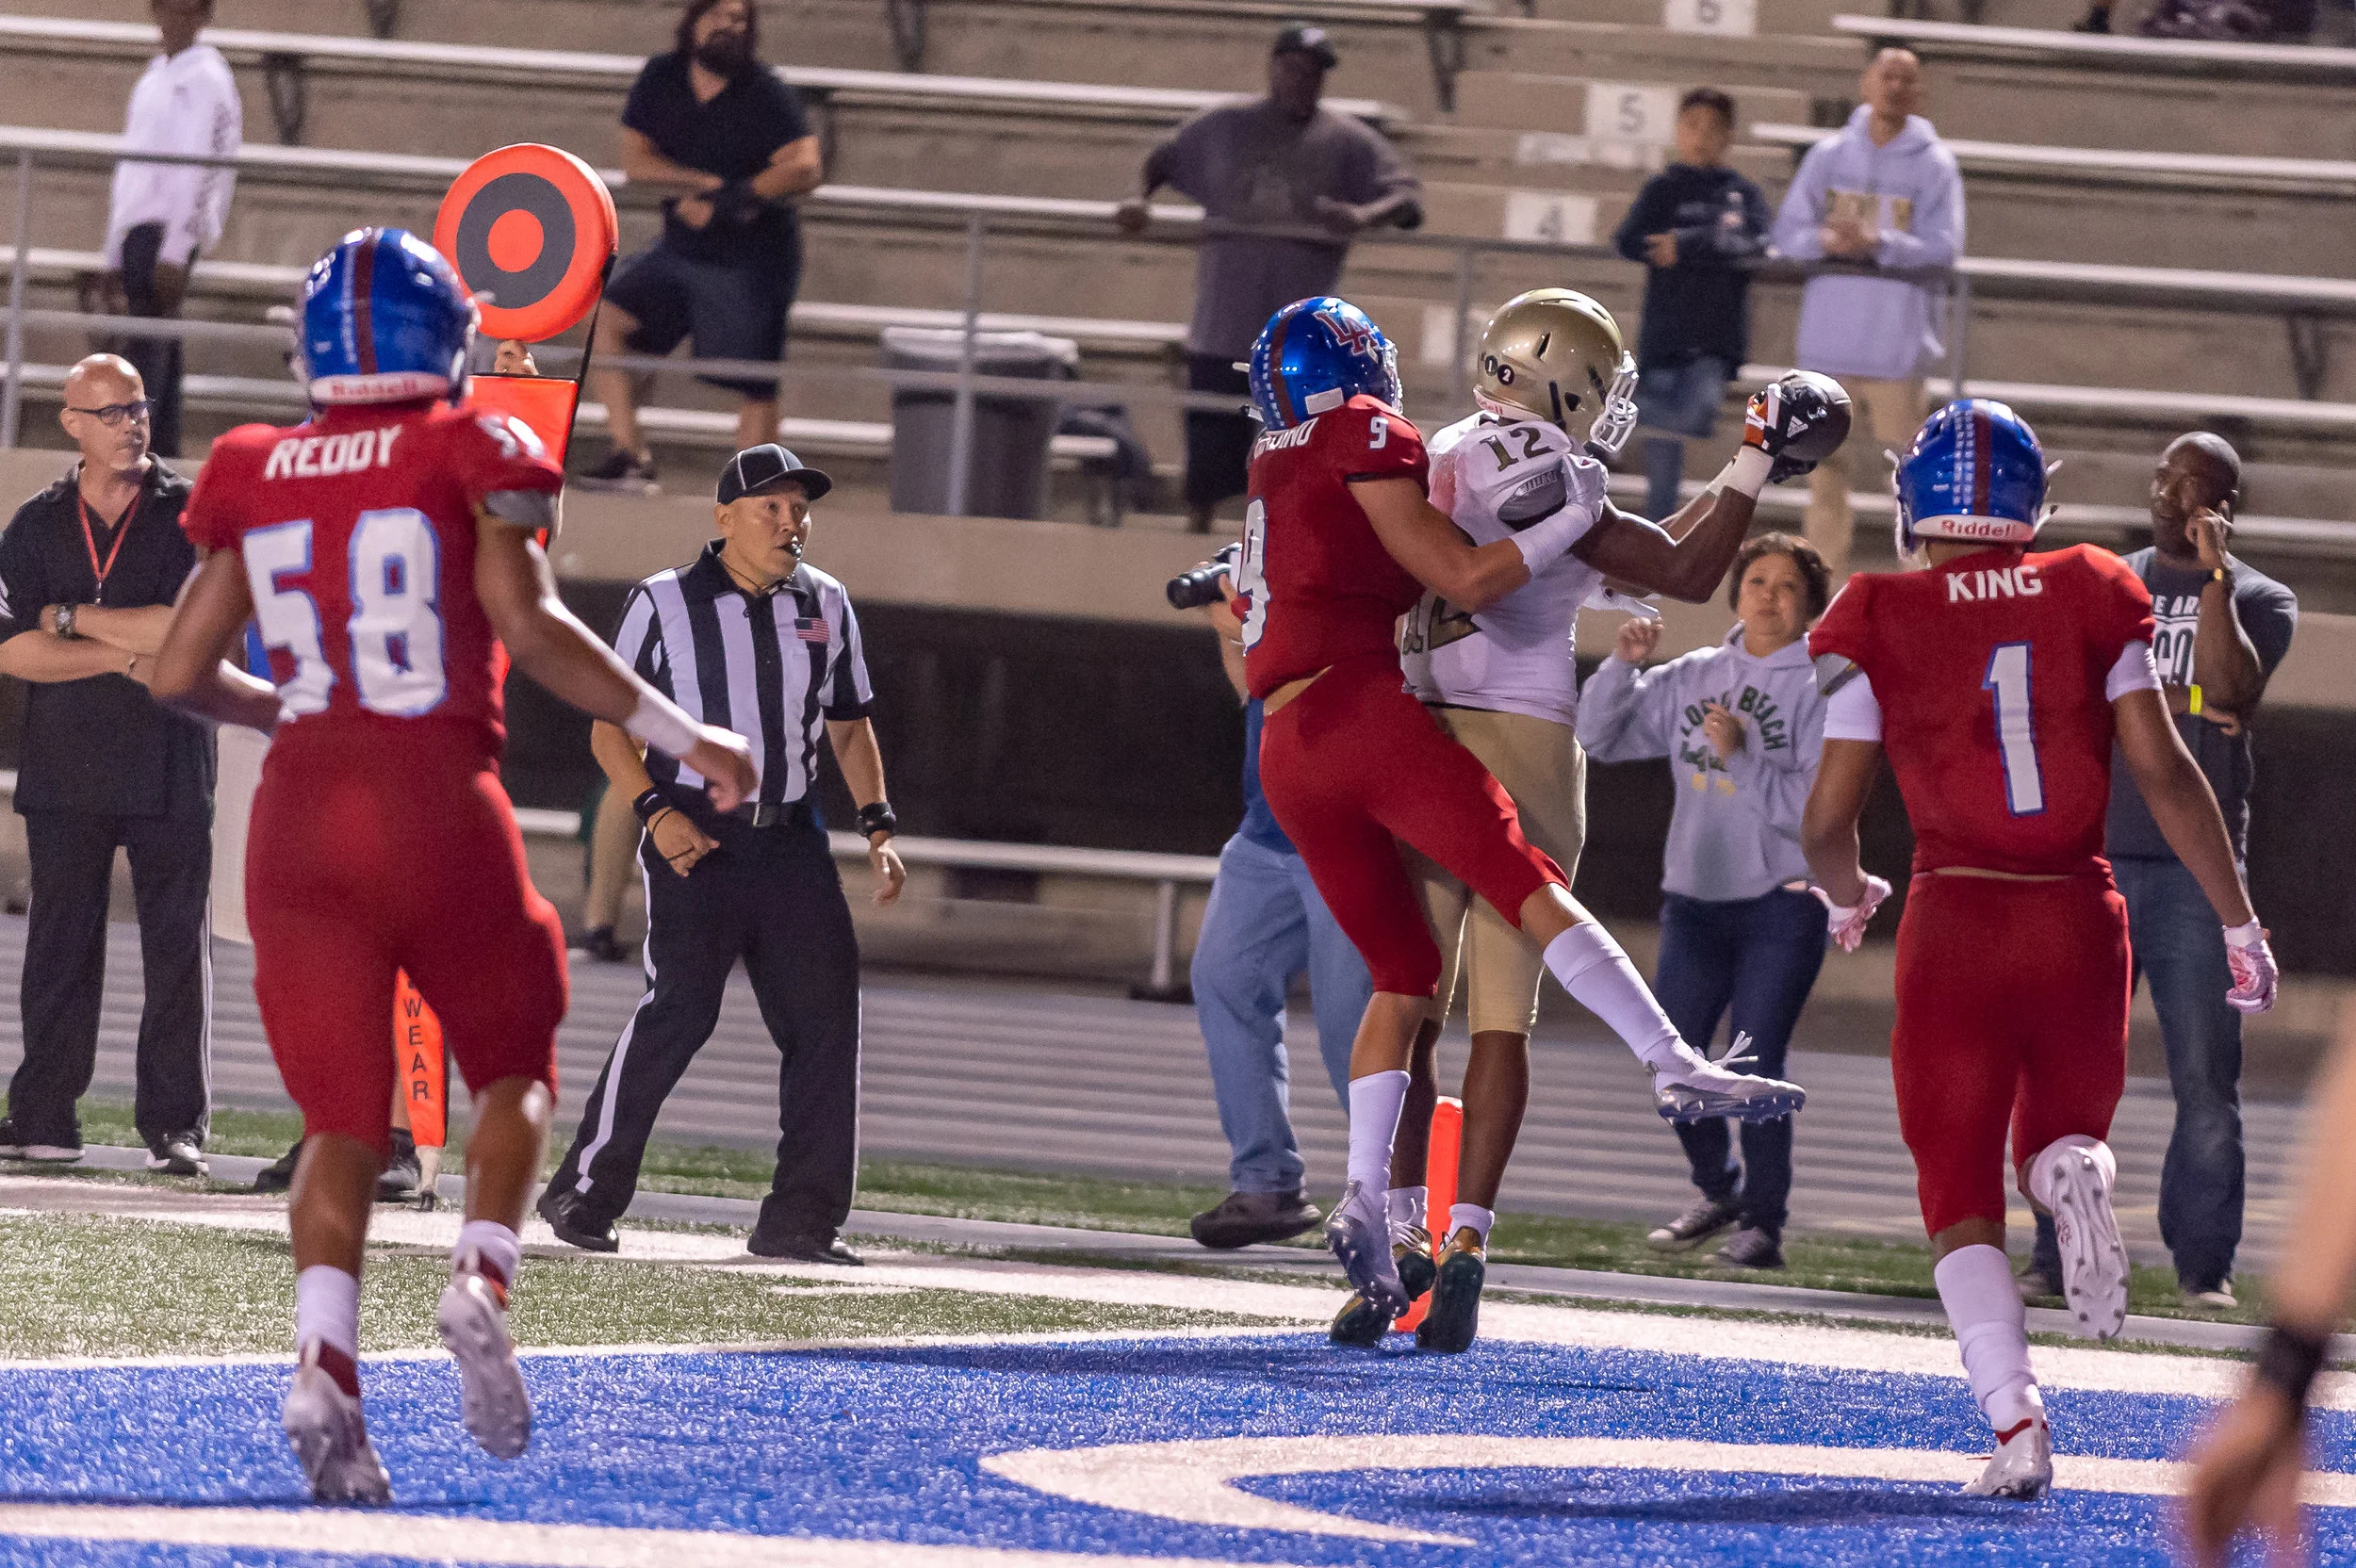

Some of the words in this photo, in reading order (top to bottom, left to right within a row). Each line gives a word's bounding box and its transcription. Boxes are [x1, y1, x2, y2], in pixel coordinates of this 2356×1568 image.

[1617, 93, 1645, 133] 5
[1535, 203, 1564, 242] 4
[1313, 310, 1379, 356] LA
[264, 424, 402, 480] REDDY
[1369, 416, 1388, 449] 9
[1479, 427, 1556, 472] 12
[1946, 566, 2043, 603] KING
[242, 508, 449, 723] 58
[1738, 685, 1788, 751] BEACH
[1981, 639, 2048, 819] 1
[402, 978, 431, 1102] WEAR
